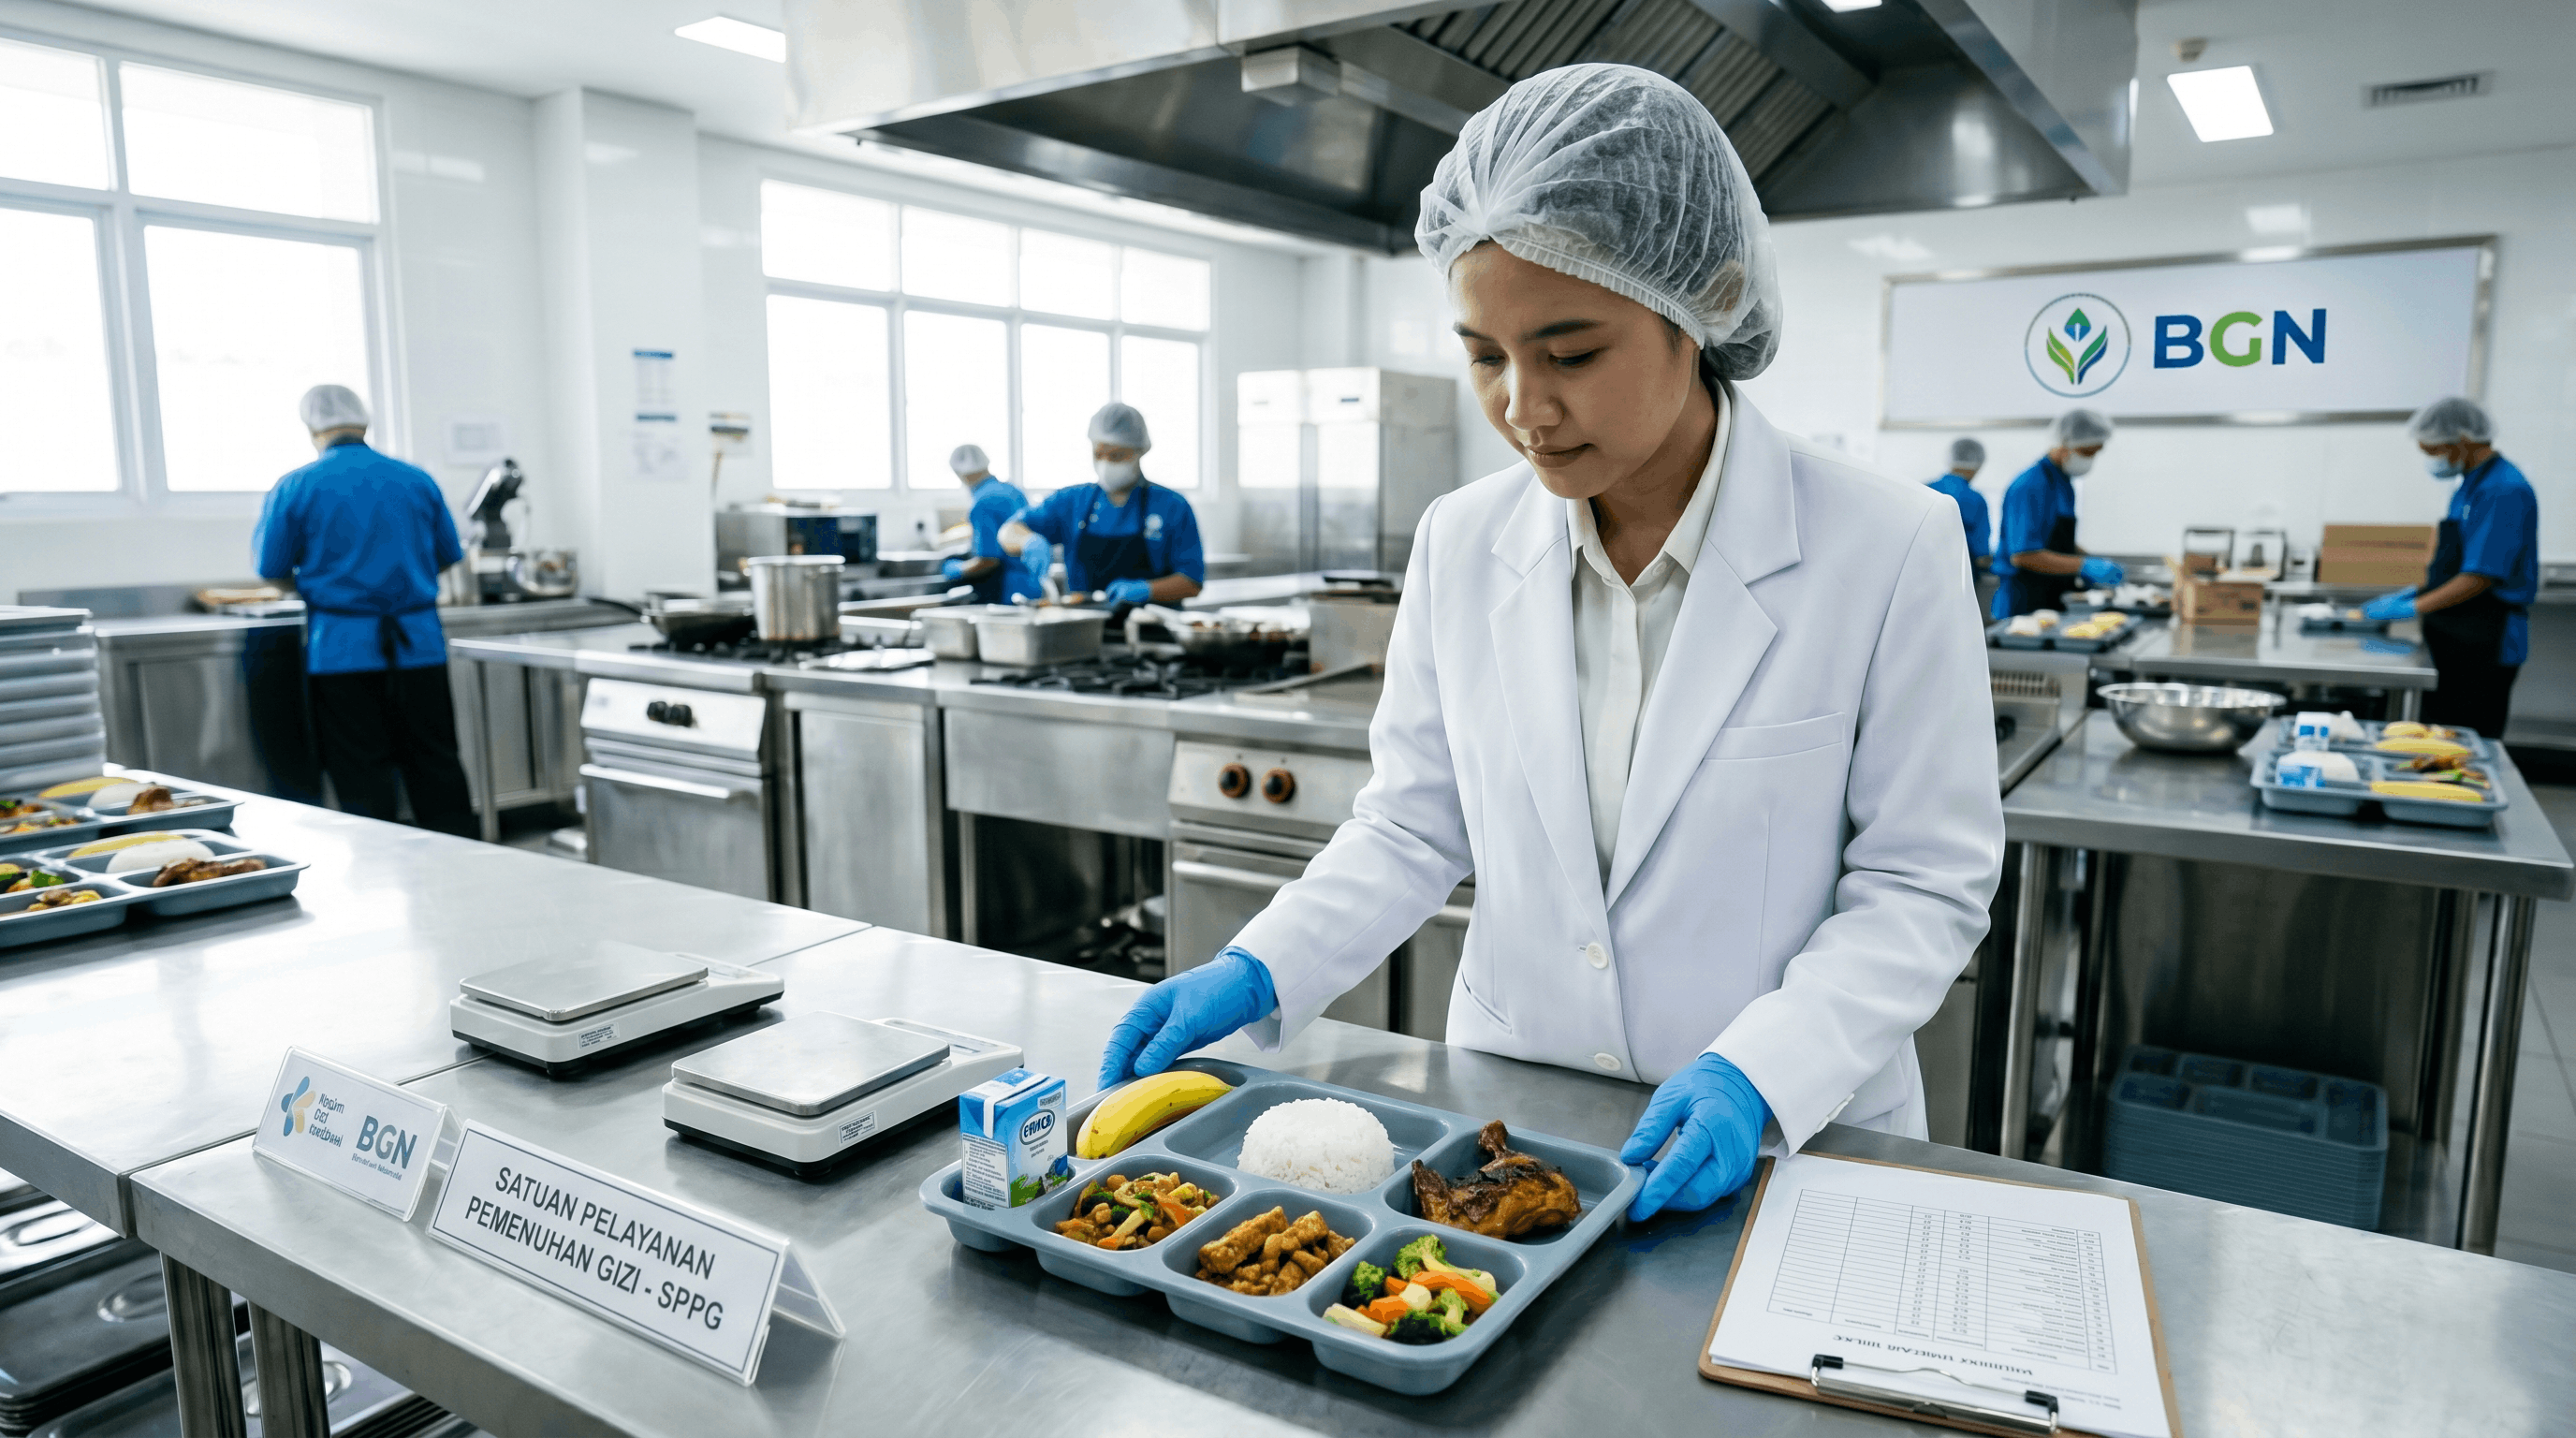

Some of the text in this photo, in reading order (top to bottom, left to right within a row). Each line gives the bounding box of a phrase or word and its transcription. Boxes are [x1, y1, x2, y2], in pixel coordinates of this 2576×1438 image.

[2153, 308, 2327, 369] BGN
[356, 1115, 418, 1169] BGN
[464, 1196, 724, 1330] PEMENUHAN GIZI - SPPG
[495, 1167, 716, 1281] SATUAN PELAYANAN
